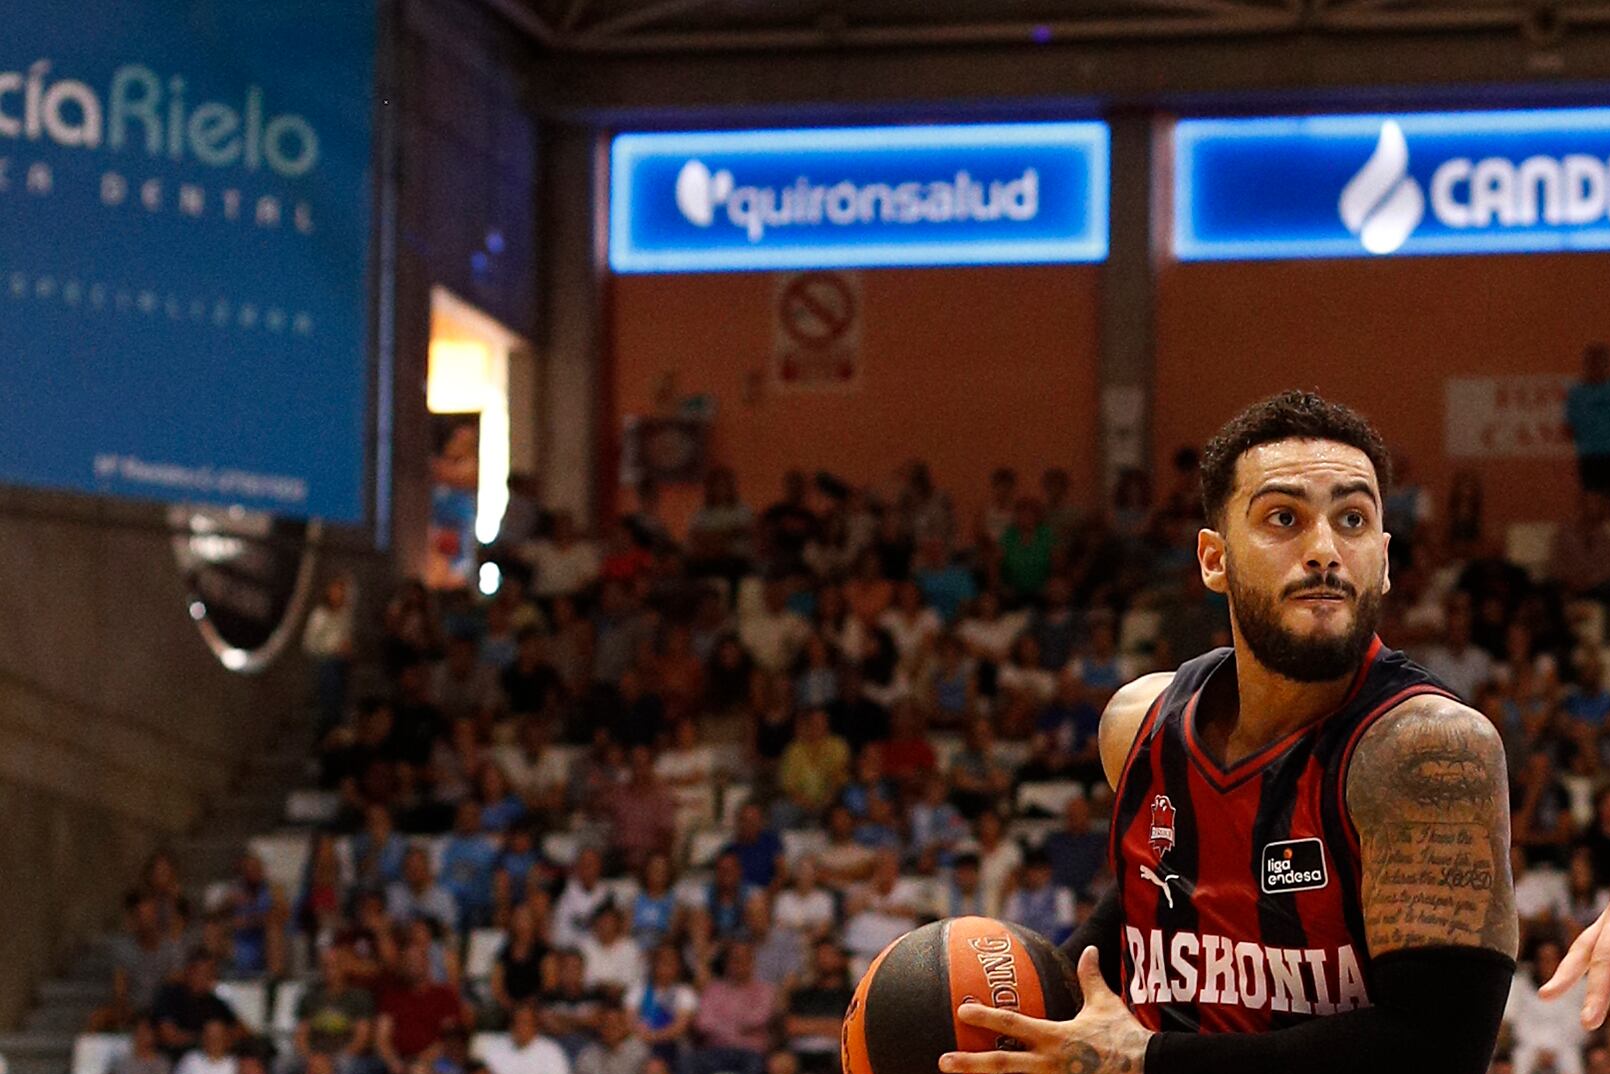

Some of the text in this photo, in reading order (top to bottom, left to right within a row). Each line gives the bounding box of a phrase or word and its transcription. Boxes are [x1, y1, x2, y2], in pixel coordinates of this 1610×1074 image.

[1267, 857, 1291, 873] liga
[1267, 868, 1322, 886] endesa
[1126, 927, 1375, 1015] BASKONIA
